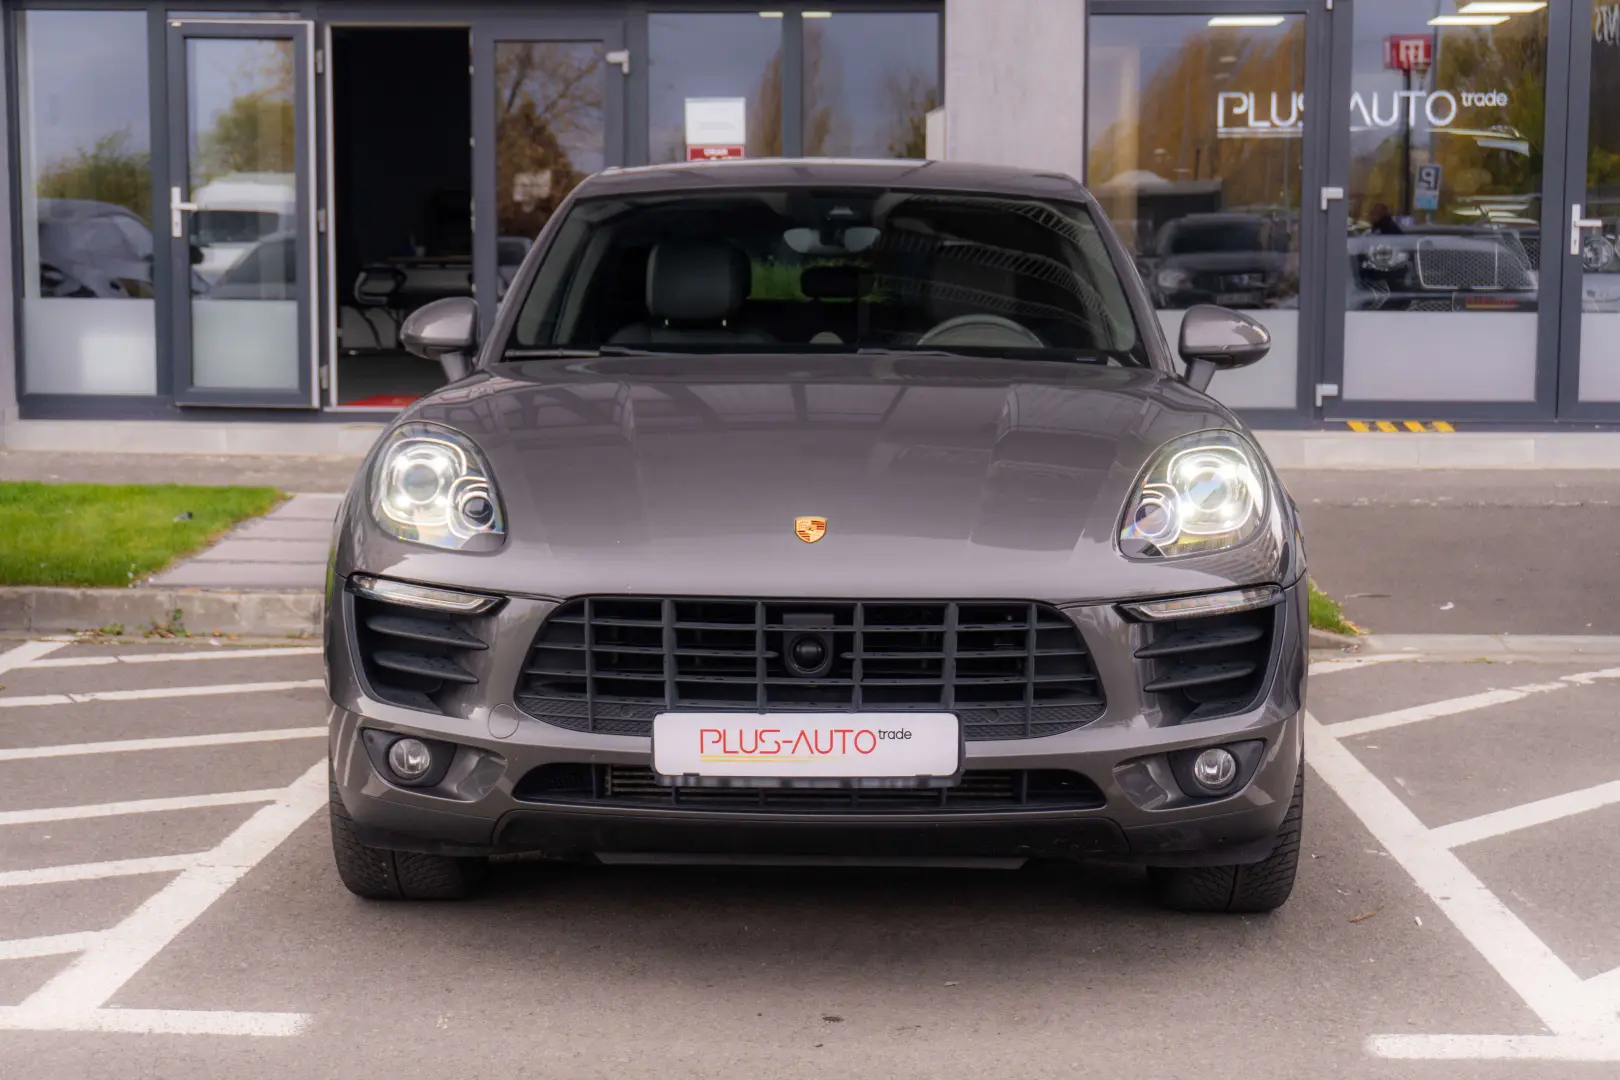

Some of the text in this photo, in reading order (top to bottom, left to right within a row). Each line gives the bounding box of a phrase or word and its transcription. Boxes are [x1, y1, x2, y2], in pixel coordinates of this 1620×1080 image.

[1461, 90, 1508, 107] trade
[700, 728, 912, 754] PLUS-AUTO trade
